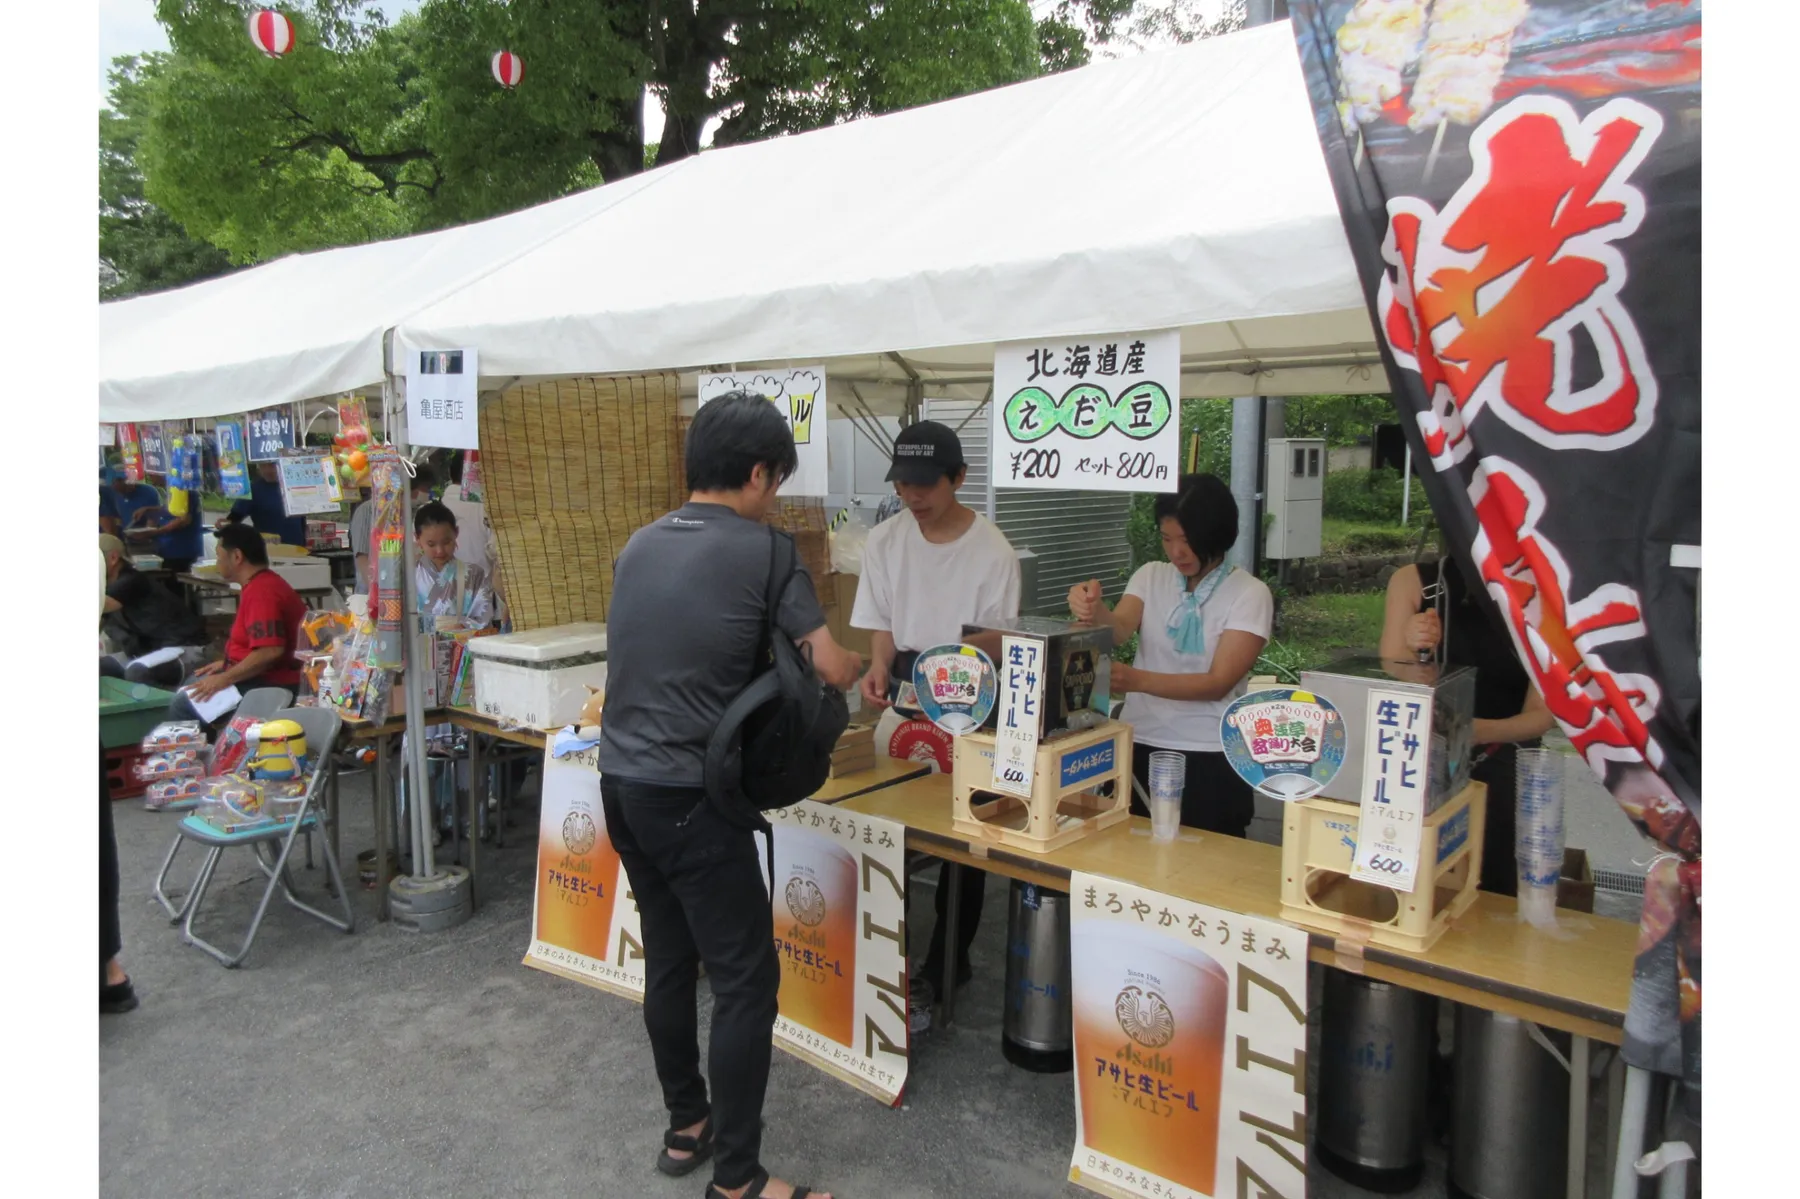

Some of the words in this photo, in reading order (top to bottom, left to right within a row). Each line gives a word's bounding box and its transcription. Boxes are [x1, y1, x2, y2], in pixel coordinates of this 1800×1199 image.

[1026, 340, 1146, 382] 北海道産
[420, 399, 463, 420] 亀屋酒店
[1019, 393, 1152, 429] えだ豆
[1010, 448, 1061, 480] ¥200
[1075, 457, 1113, 475] セット
[1116, 452, 1168, 480] 800円
[1006, 645, 1025, 728] 生ビール
[1024, 647, 1037, 716] アサヒ
[1373, 700, 1401, 804] 生ビール
[1401, 702, 1421, 788] アサヒ
[548, 869, 604, 899] アサヒ生ビール
[1084, 885, 1291, 961] まろやかなうまみ
[774, 938, 842, 977] アサヒ生ビール
[1127, 969, 1145, 978] Since
[1095, 1058, 1199, 1112] アサヒ生ビール
